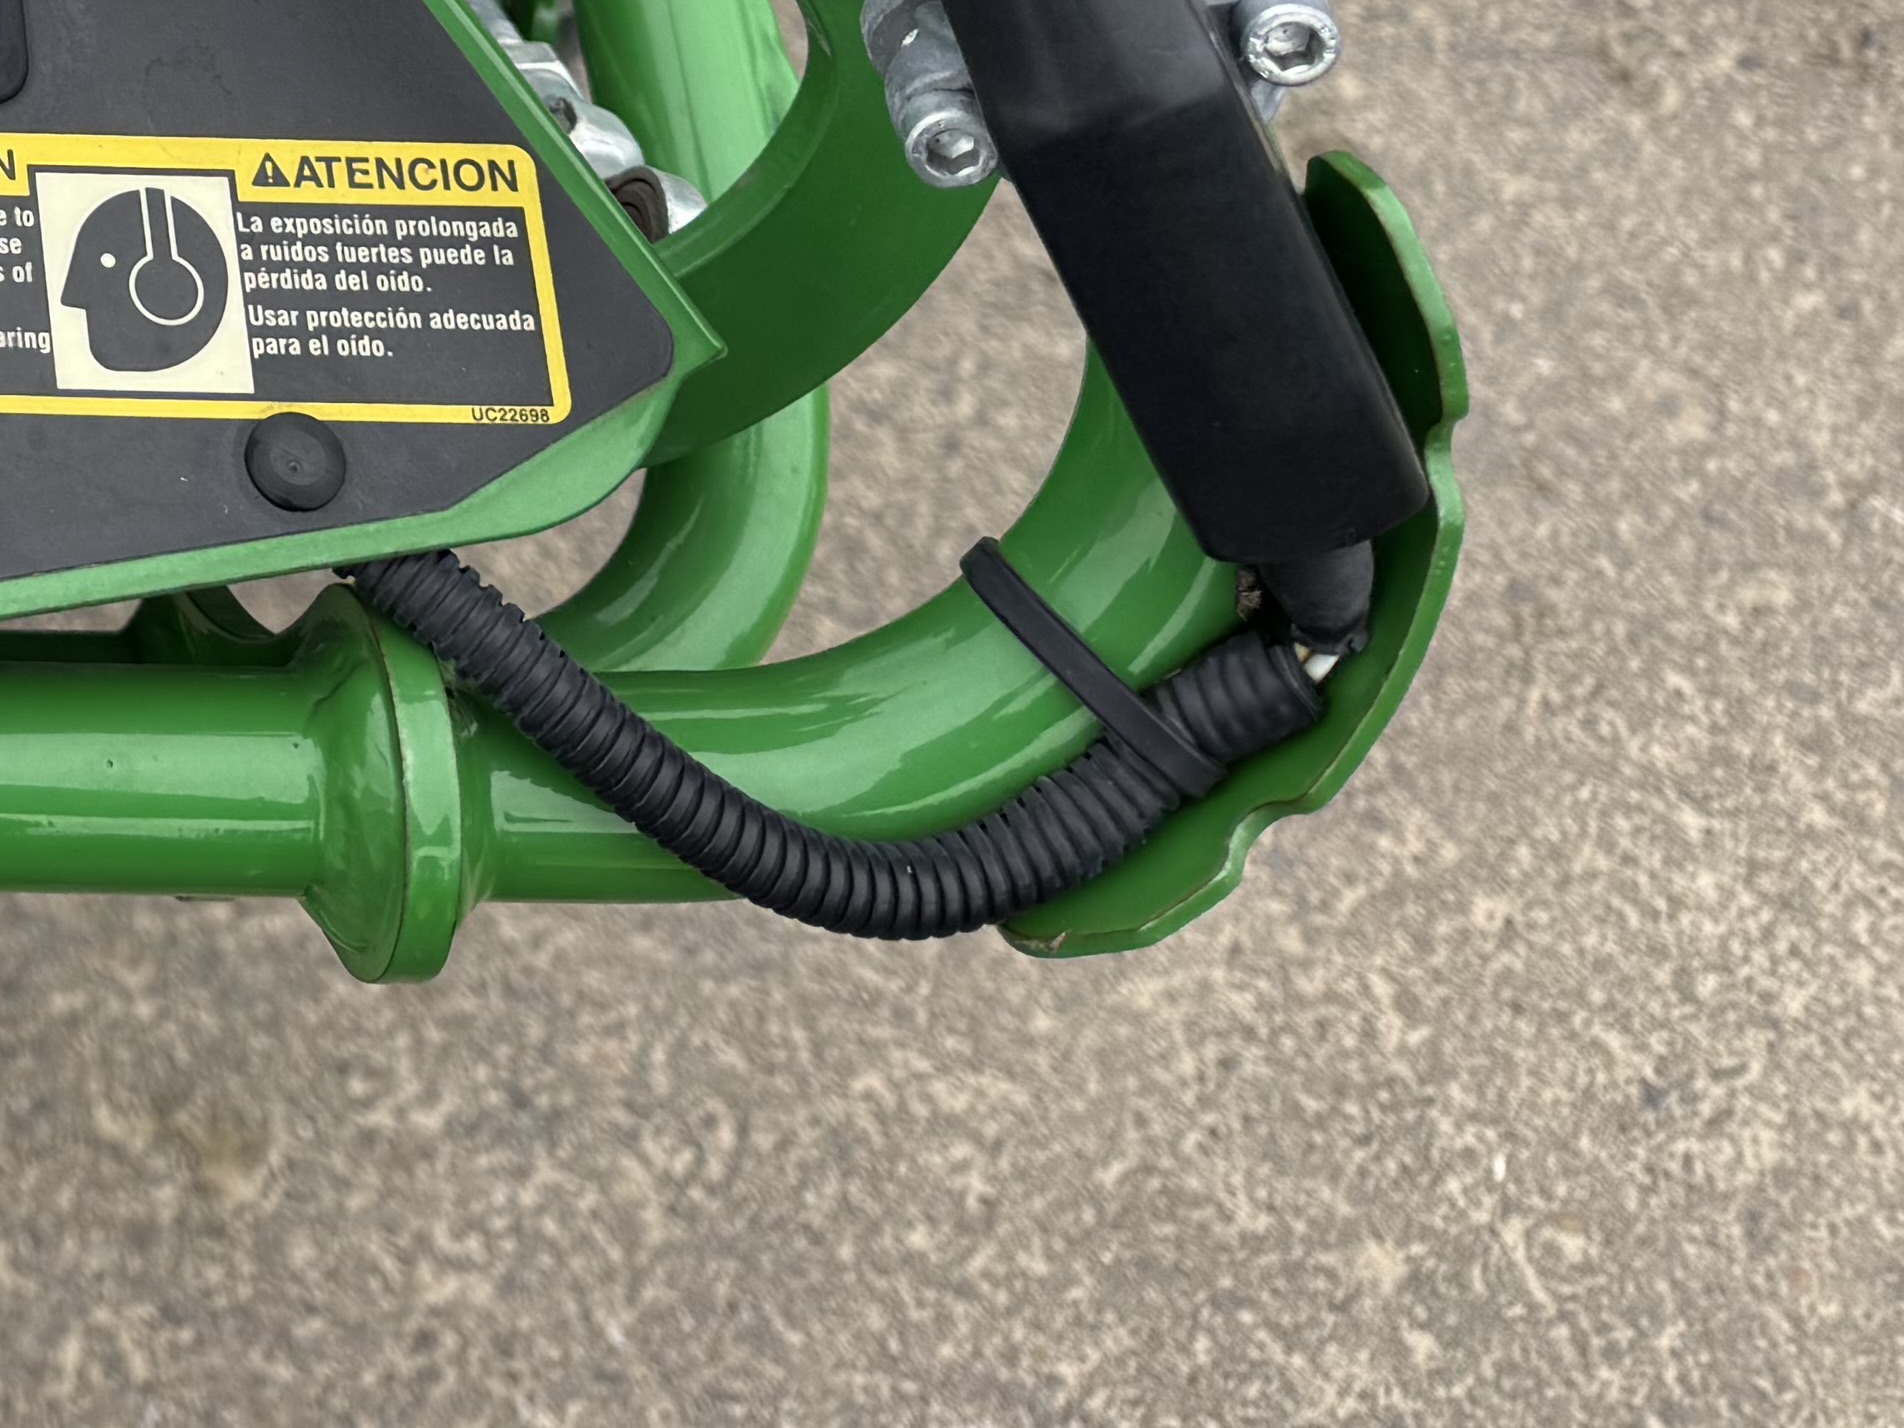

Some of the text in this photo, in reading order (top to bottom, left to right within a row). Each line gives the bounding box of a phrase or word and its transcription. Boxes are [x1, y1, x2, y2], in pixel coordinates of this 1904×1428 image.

[292, 156, 518, 193] ATENCION
[13, 206, 34, 228] to
[236, 211, 518, 242] La exposición prolongada
[240, 239, 513, 269] a ruidos fuertes puede la
[11, 261, 32, 283] of
[244, 267, 431, 293] pérdida del oído.
[248, 304, 535, 332] Usar protección adecuada
[252, 334, 393, 359] para el oído.
[472, 407, 550, 423] UC22698
